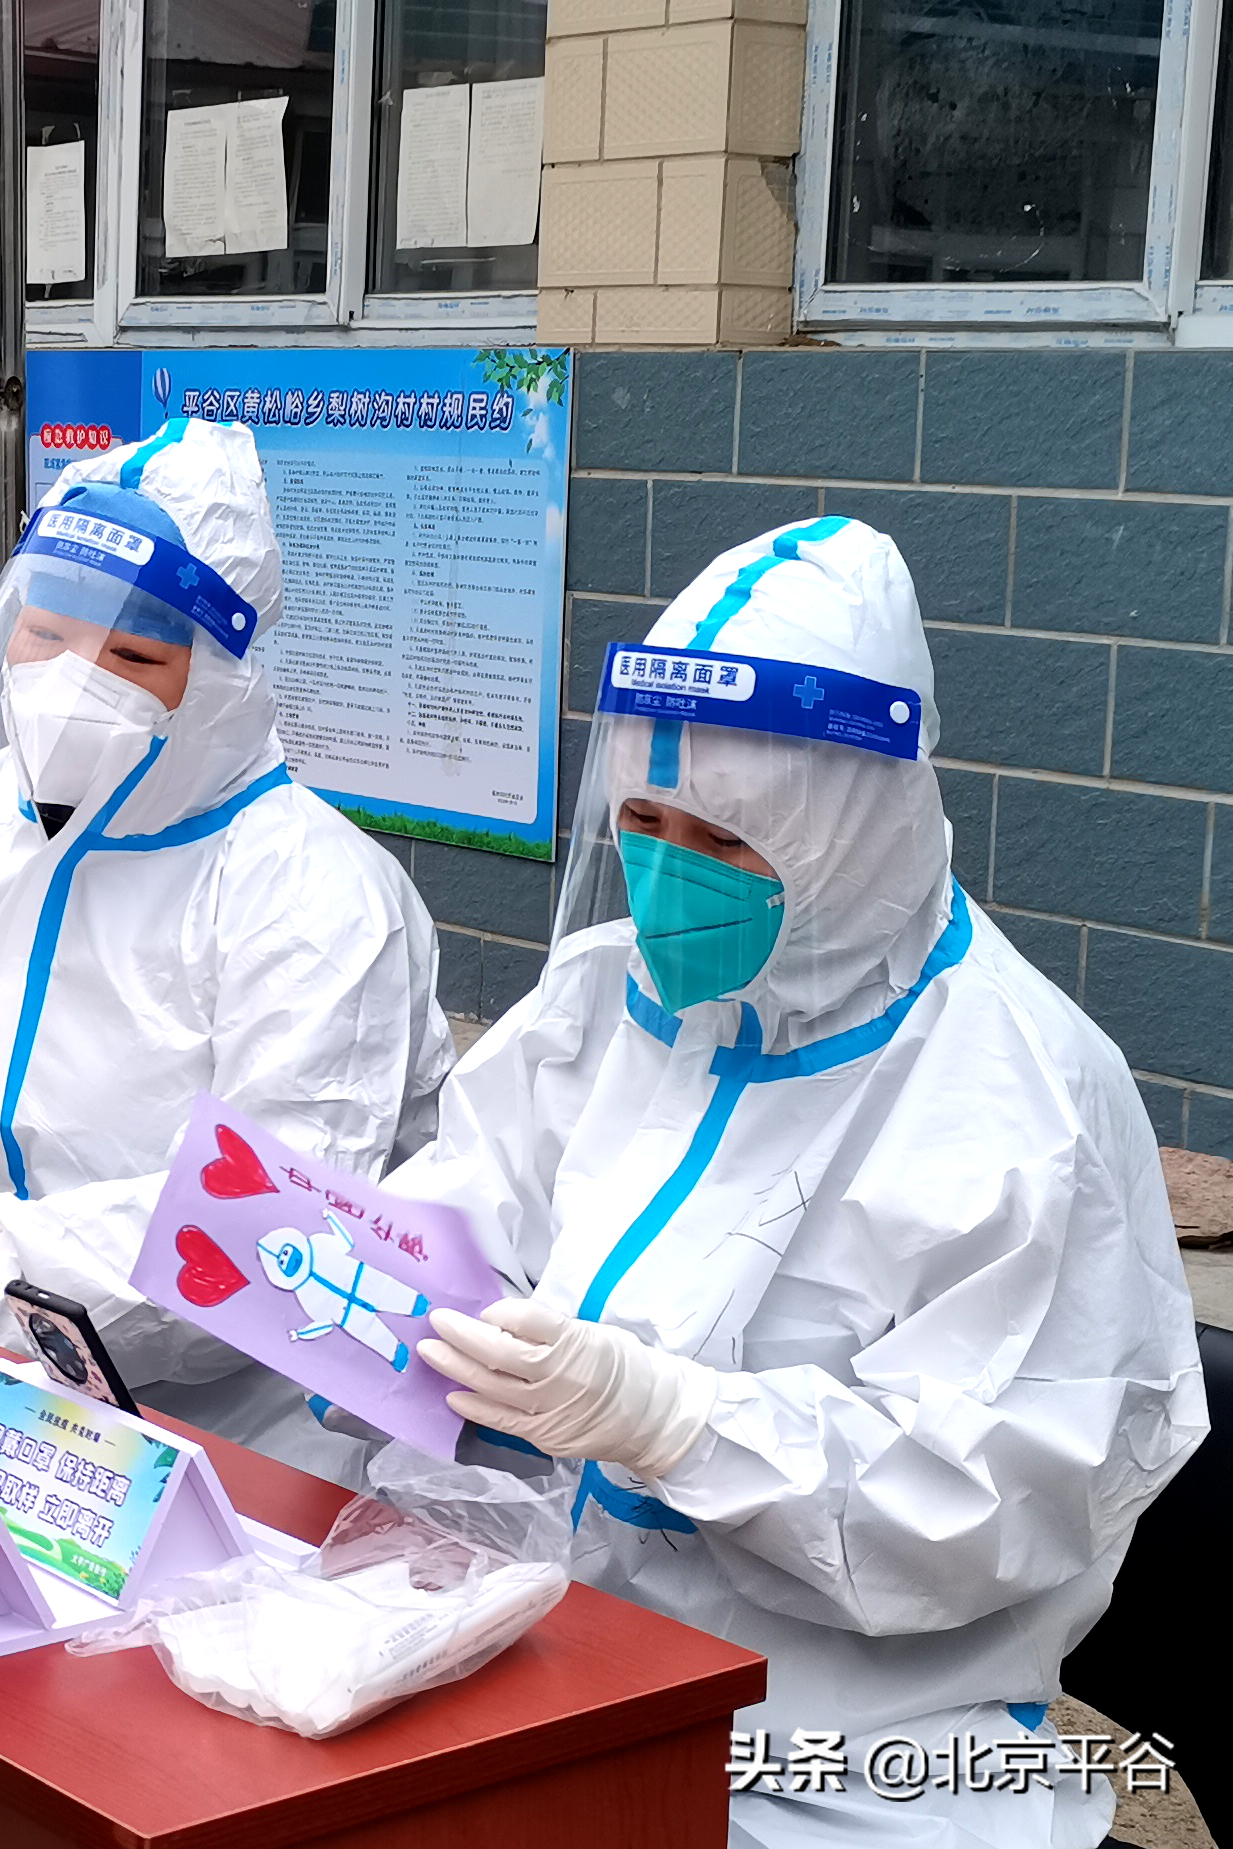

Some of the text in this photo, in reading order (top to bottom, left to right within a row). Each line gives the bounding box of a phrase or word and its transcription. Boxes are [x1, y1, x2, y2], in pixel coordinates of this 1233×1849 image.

[182, 387, 514, 431] 平谷区黄松峪乡梨树沟村村规民约
[47, 513, 143, 552] 医用隔离面罩
[620, 656, 739, 687] 医用隔离面罩
[55, 1451, 132, 1507] 保持距离
[38, 1493, 114, 1548] 立即离开
